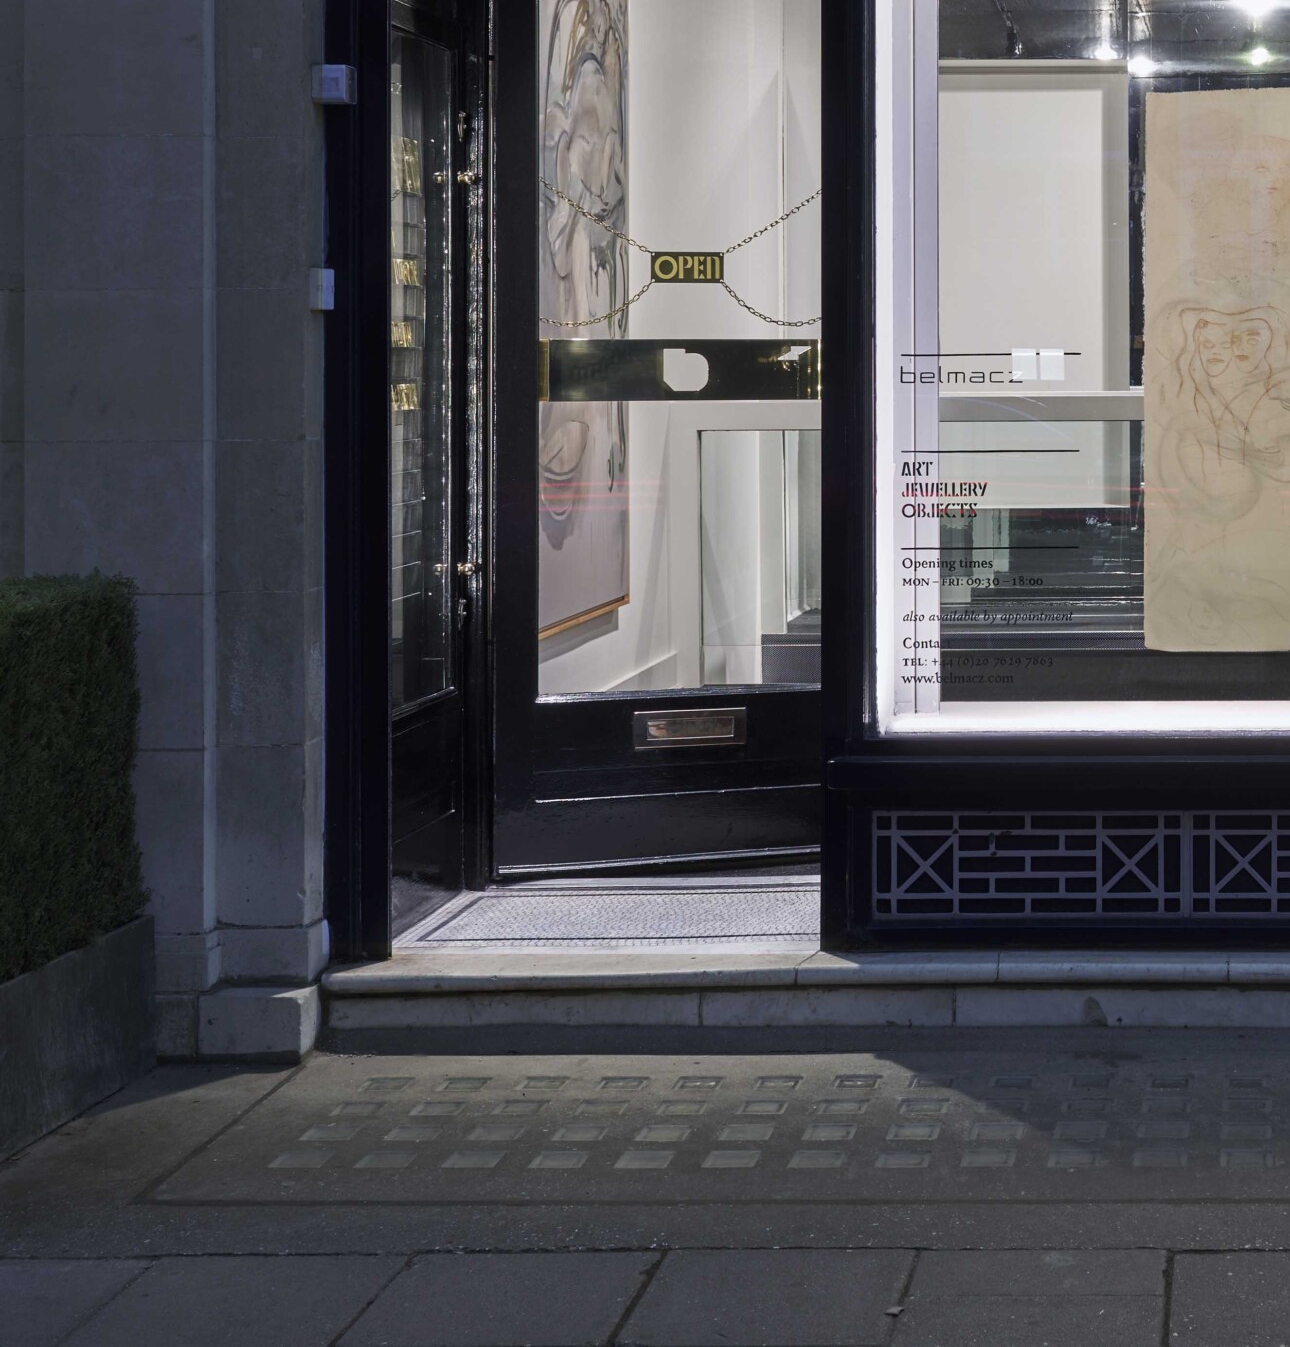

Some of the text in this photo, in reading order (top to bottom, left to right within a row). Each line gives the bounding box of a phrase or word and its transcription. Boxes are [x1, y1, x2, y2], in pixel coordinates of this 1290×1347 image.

[654, 255, 720, 280] OPEN
[900, 366, 1024, 384] belmacz
[901, 462, 934, 477] ART
[902, 482, 988, 497] JEWELLERY
[902, 503, 977, 518] OBJECTS
[902, 557, 993, 571] Opening times
[902, 578, 930, 587] MON
[941, 578, 964, 587] FRI:
[966, 577, 1000, 588] 09:30
[1012, 575, 1043, 586] 18:00
[902, 610, 1073, 625] also available by appointment
[902, 658, 928, 667] TEL:
[901, 672, 1014, 684] www.belmacz.com
